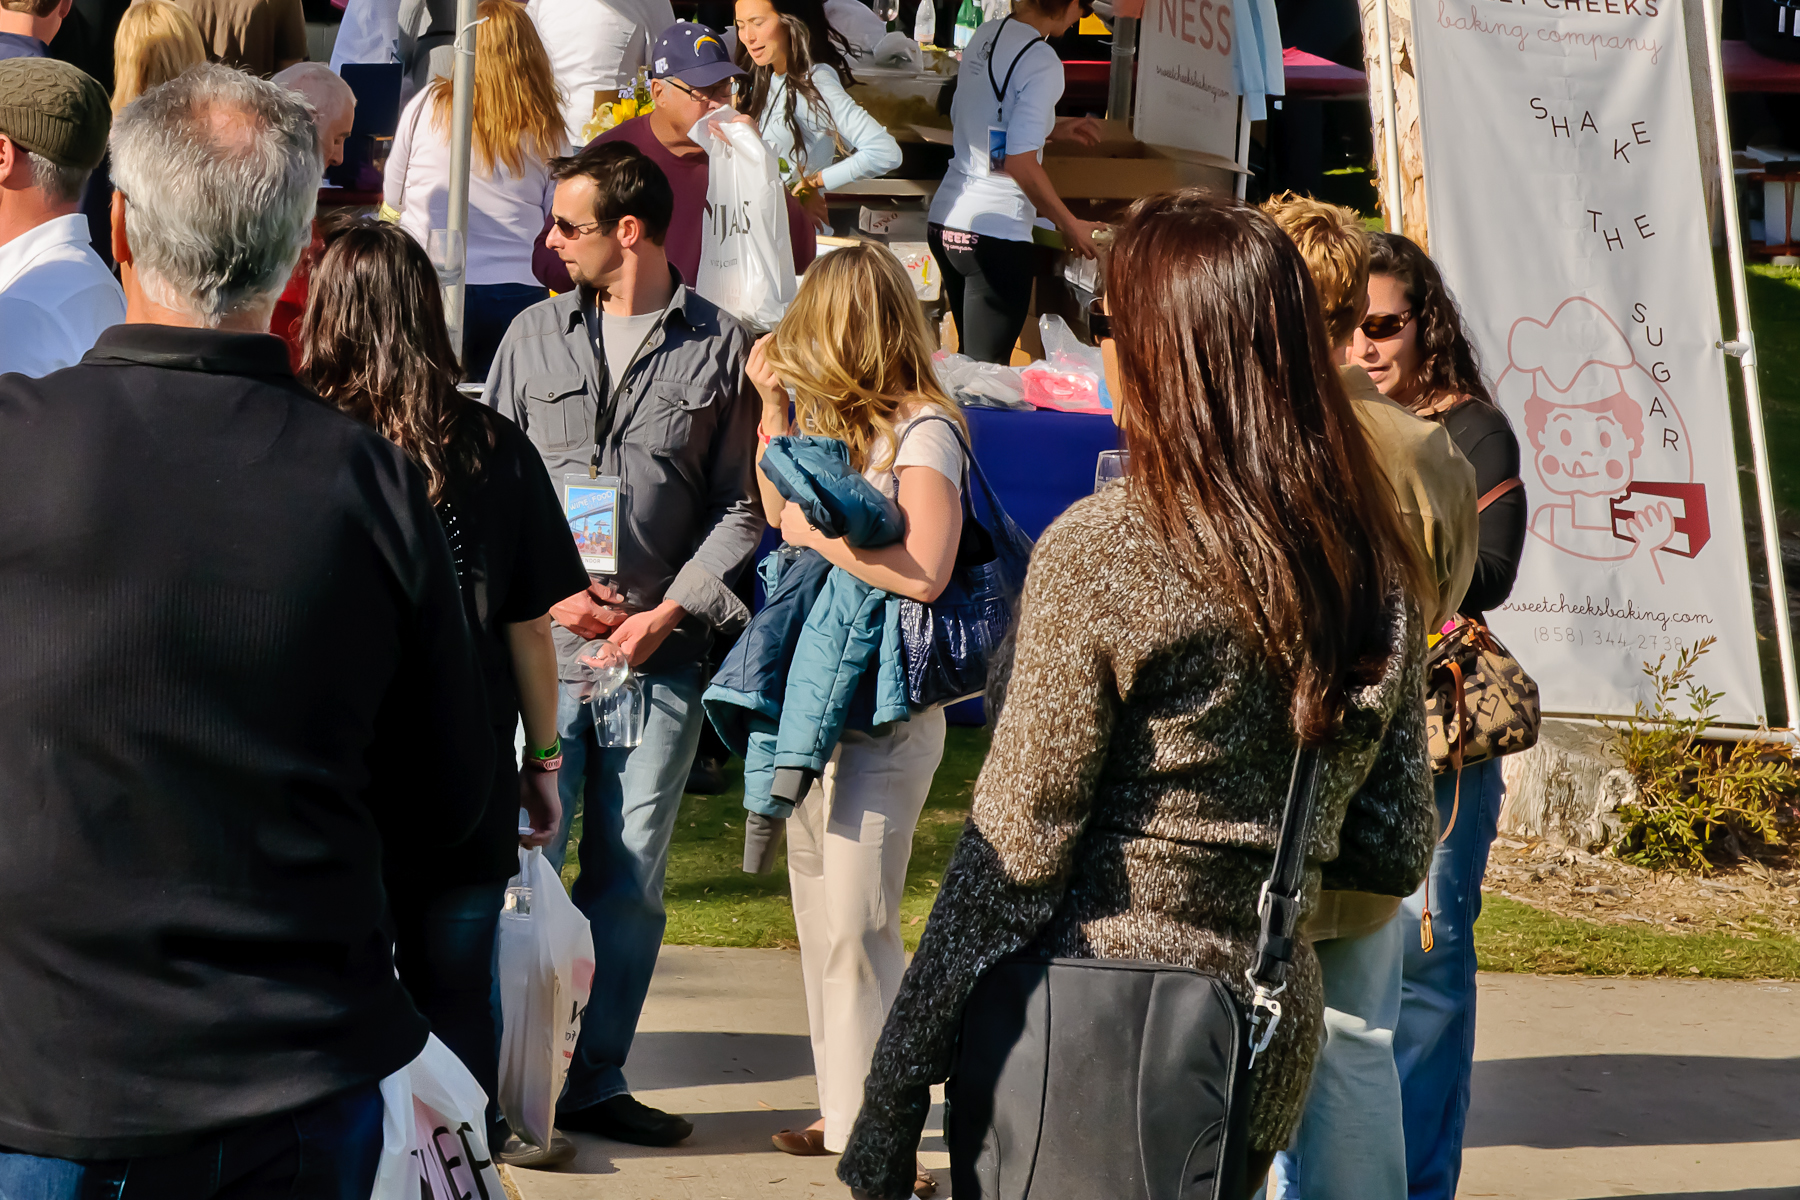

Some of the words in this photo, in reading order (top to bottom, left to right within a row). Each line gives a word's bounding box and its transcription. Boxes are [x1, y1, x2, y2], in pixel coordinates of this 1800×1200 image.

[1437, 0, 1529, 51] baking
[1537, 28, 1663, 65] company
[1530, 97, 1651, 164] SHAKE
[1587, 209, 1656, 252] THE
[1632, 302, 1679, 452] SUGAR
[591, 490, 613, 503] FOOD
[1500, 593, 1714, 631] sweetcheeksbaking.com
[1534, 626, 1584, 646] (858)
[1594, 630, 1627, 647] 344
[1638, 635, 1684, 652] 2738
